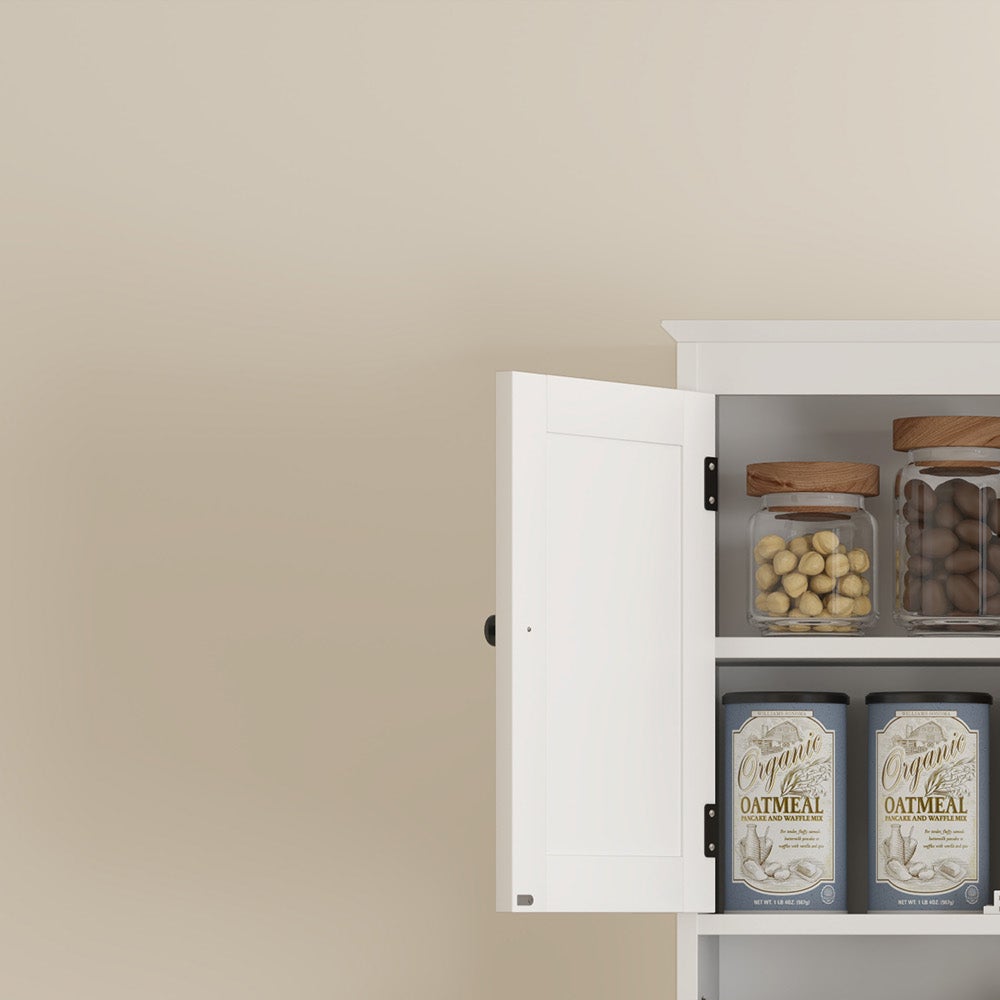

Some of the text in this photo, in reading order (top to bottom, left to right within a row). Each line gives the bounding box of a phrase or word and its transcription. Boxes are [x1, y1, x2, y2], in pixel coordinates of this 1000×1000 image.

[738, 732, 822, 794] Organic
[882, 732, 966, 794] Organic
[740, 796, 824, 814] OATMEAL
[884, 796, 968, 814] OATMEAL
